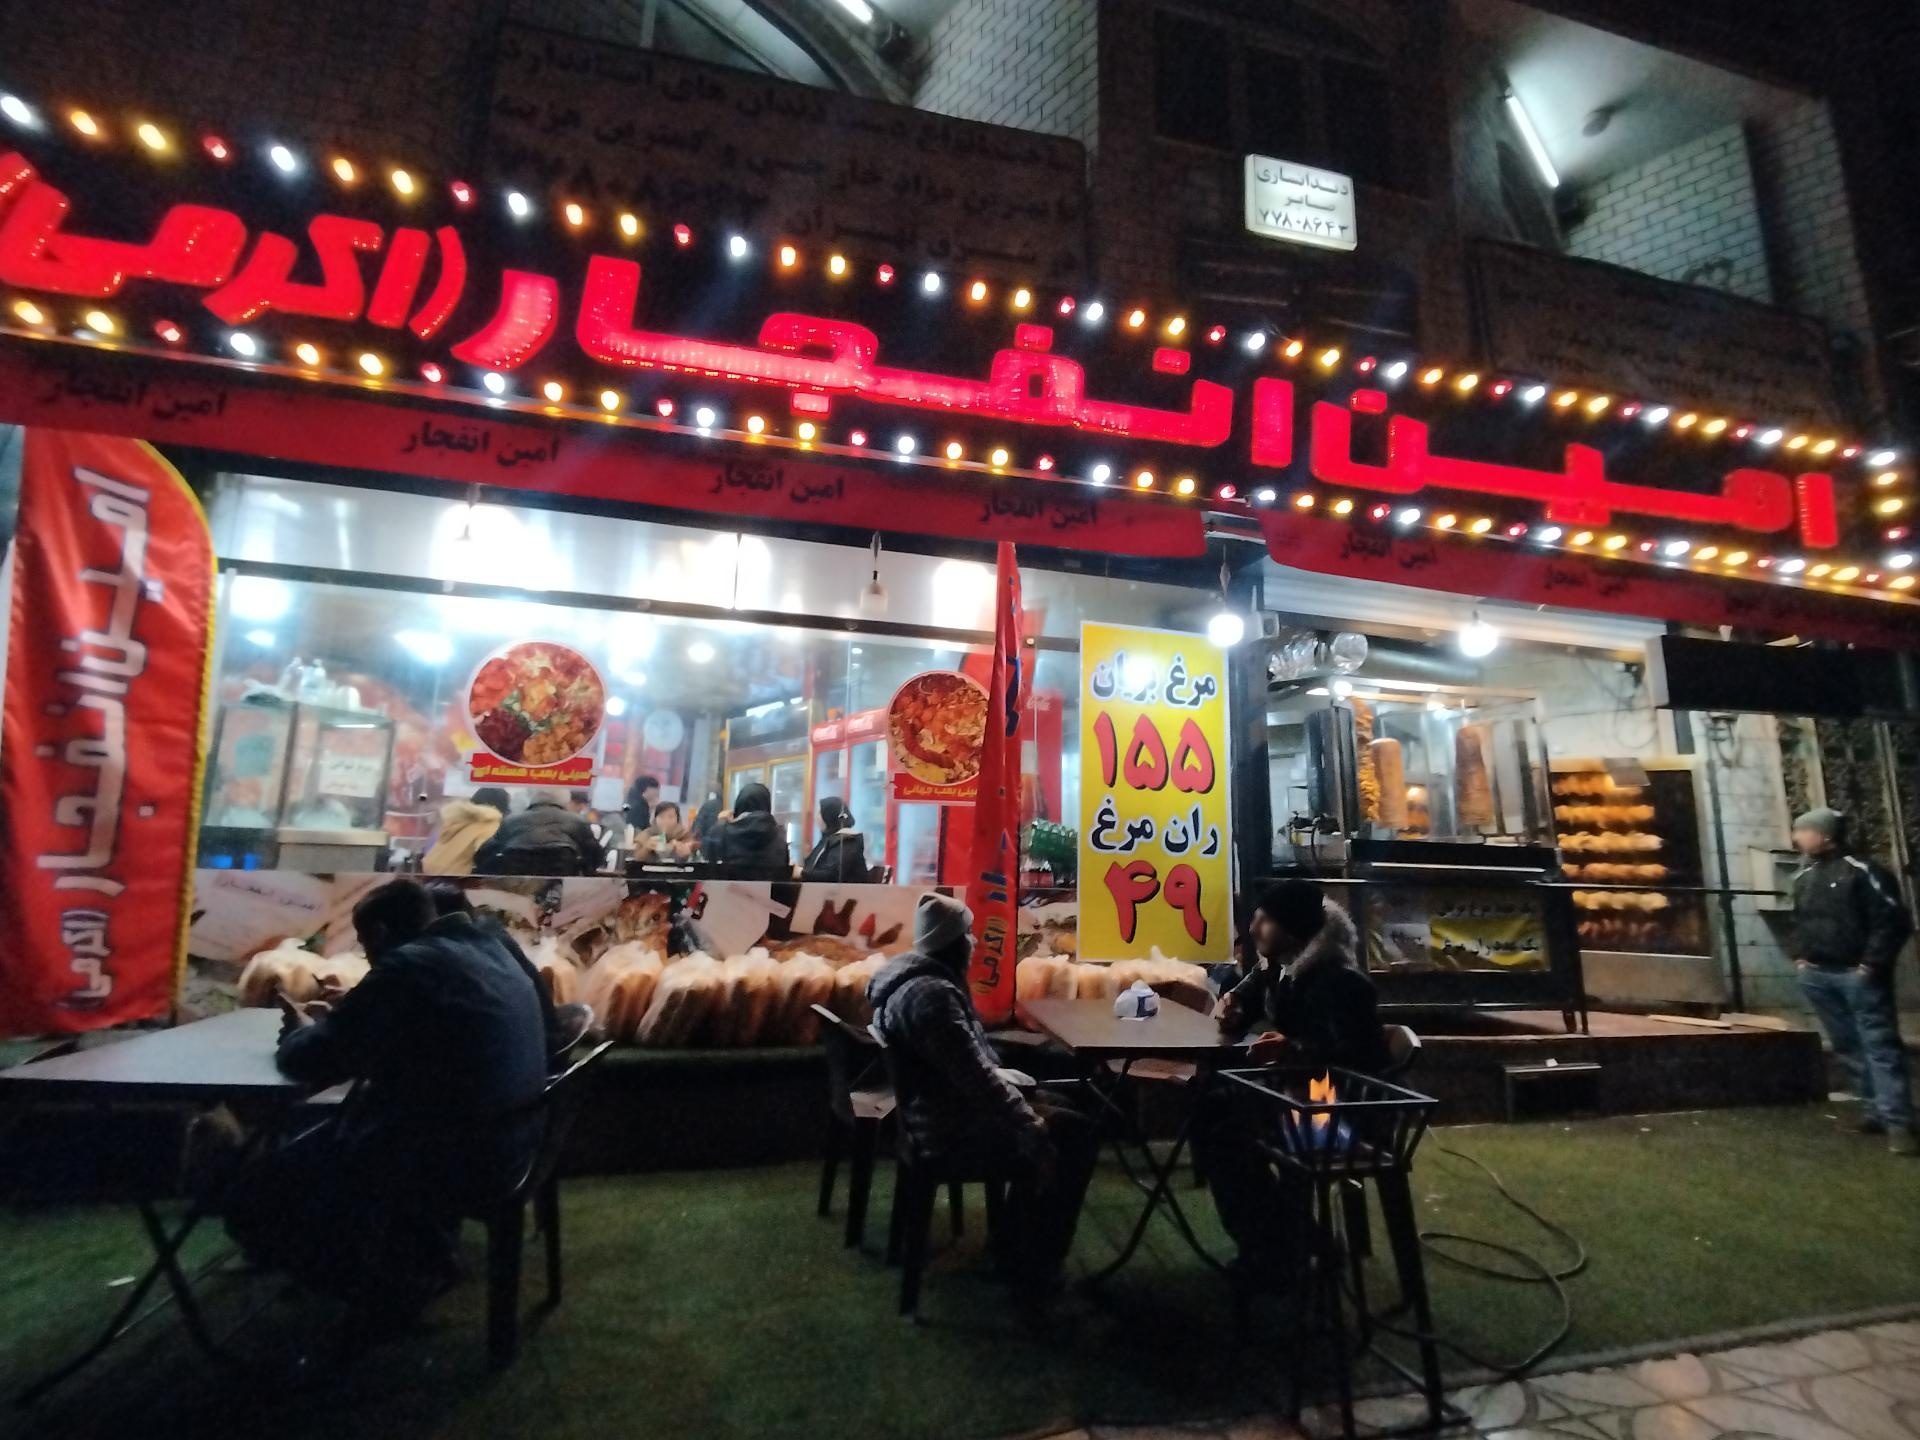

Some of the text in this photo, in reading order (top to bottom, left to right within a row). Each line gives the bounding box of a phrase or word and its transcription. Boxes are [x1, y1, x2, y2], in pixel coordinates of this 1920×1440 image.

[1257, 166, 1348, 195] دندانسازی
[451, 253, 1293, 468] انفجار
[402, 421, 560, 467] امین انفجار
[709, 461, 844, 504] امین انفجار
[1311, 389, 1838, 549] امین
[60, 465, 165, 676] امین
[1166, 655, 1216, 706] مرغ
[35, 671, 155, 897] انفجار
[1093, 710, 1216, 794] ۱۵۵
[1091, 798, 1219, 855] ران مرغ
[1104, 859, 1208, 945] ۴۹
